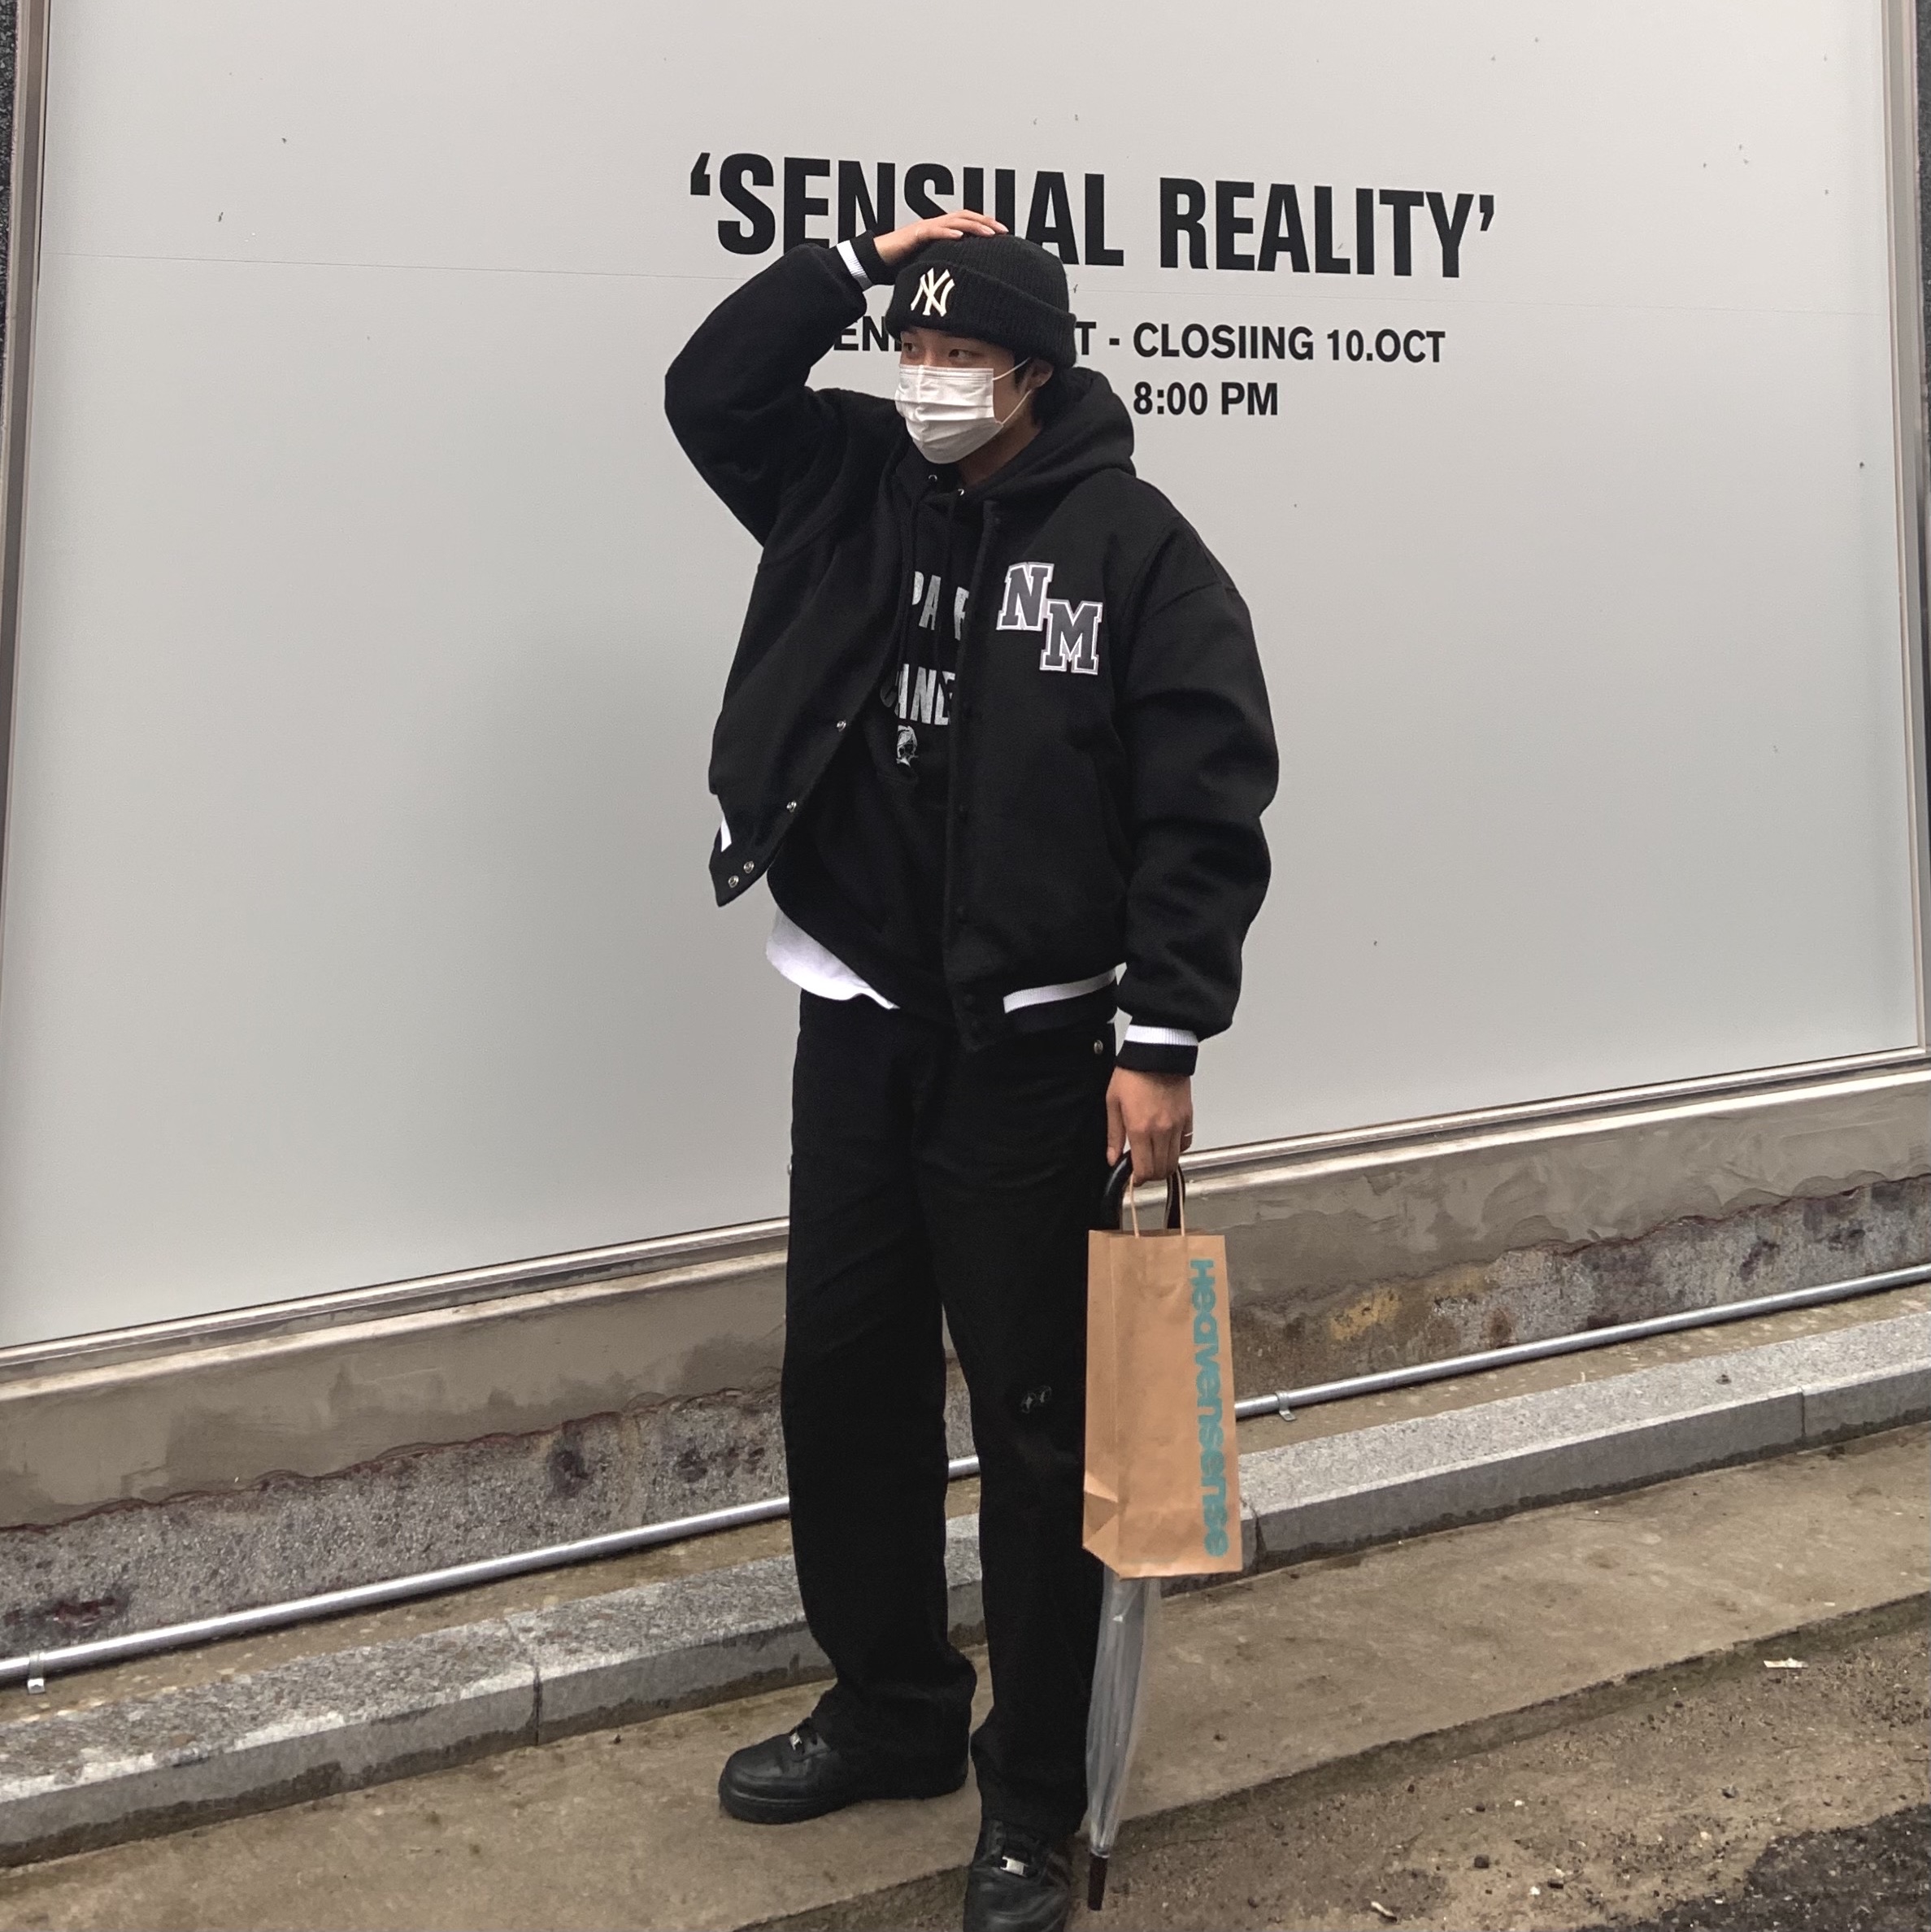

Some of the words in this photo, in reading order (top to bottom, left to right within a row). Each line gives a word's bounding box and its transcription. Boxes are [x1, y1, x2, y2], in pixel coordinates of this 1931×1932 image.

[1159, 177, 1494, 278] REALITY’
[910, 267, 956, 318] NY
[1133, 322, 1314, 360] CLOSIING
[1327, 328, 1446, 363] 10.OCT
[1133, 381, 1209, 416] 8:00
[1221, 381, 1278, 416] PM
[995, 561, 1103, 676] NM
[1189, 1259, 1229, 1557] Heavensense
